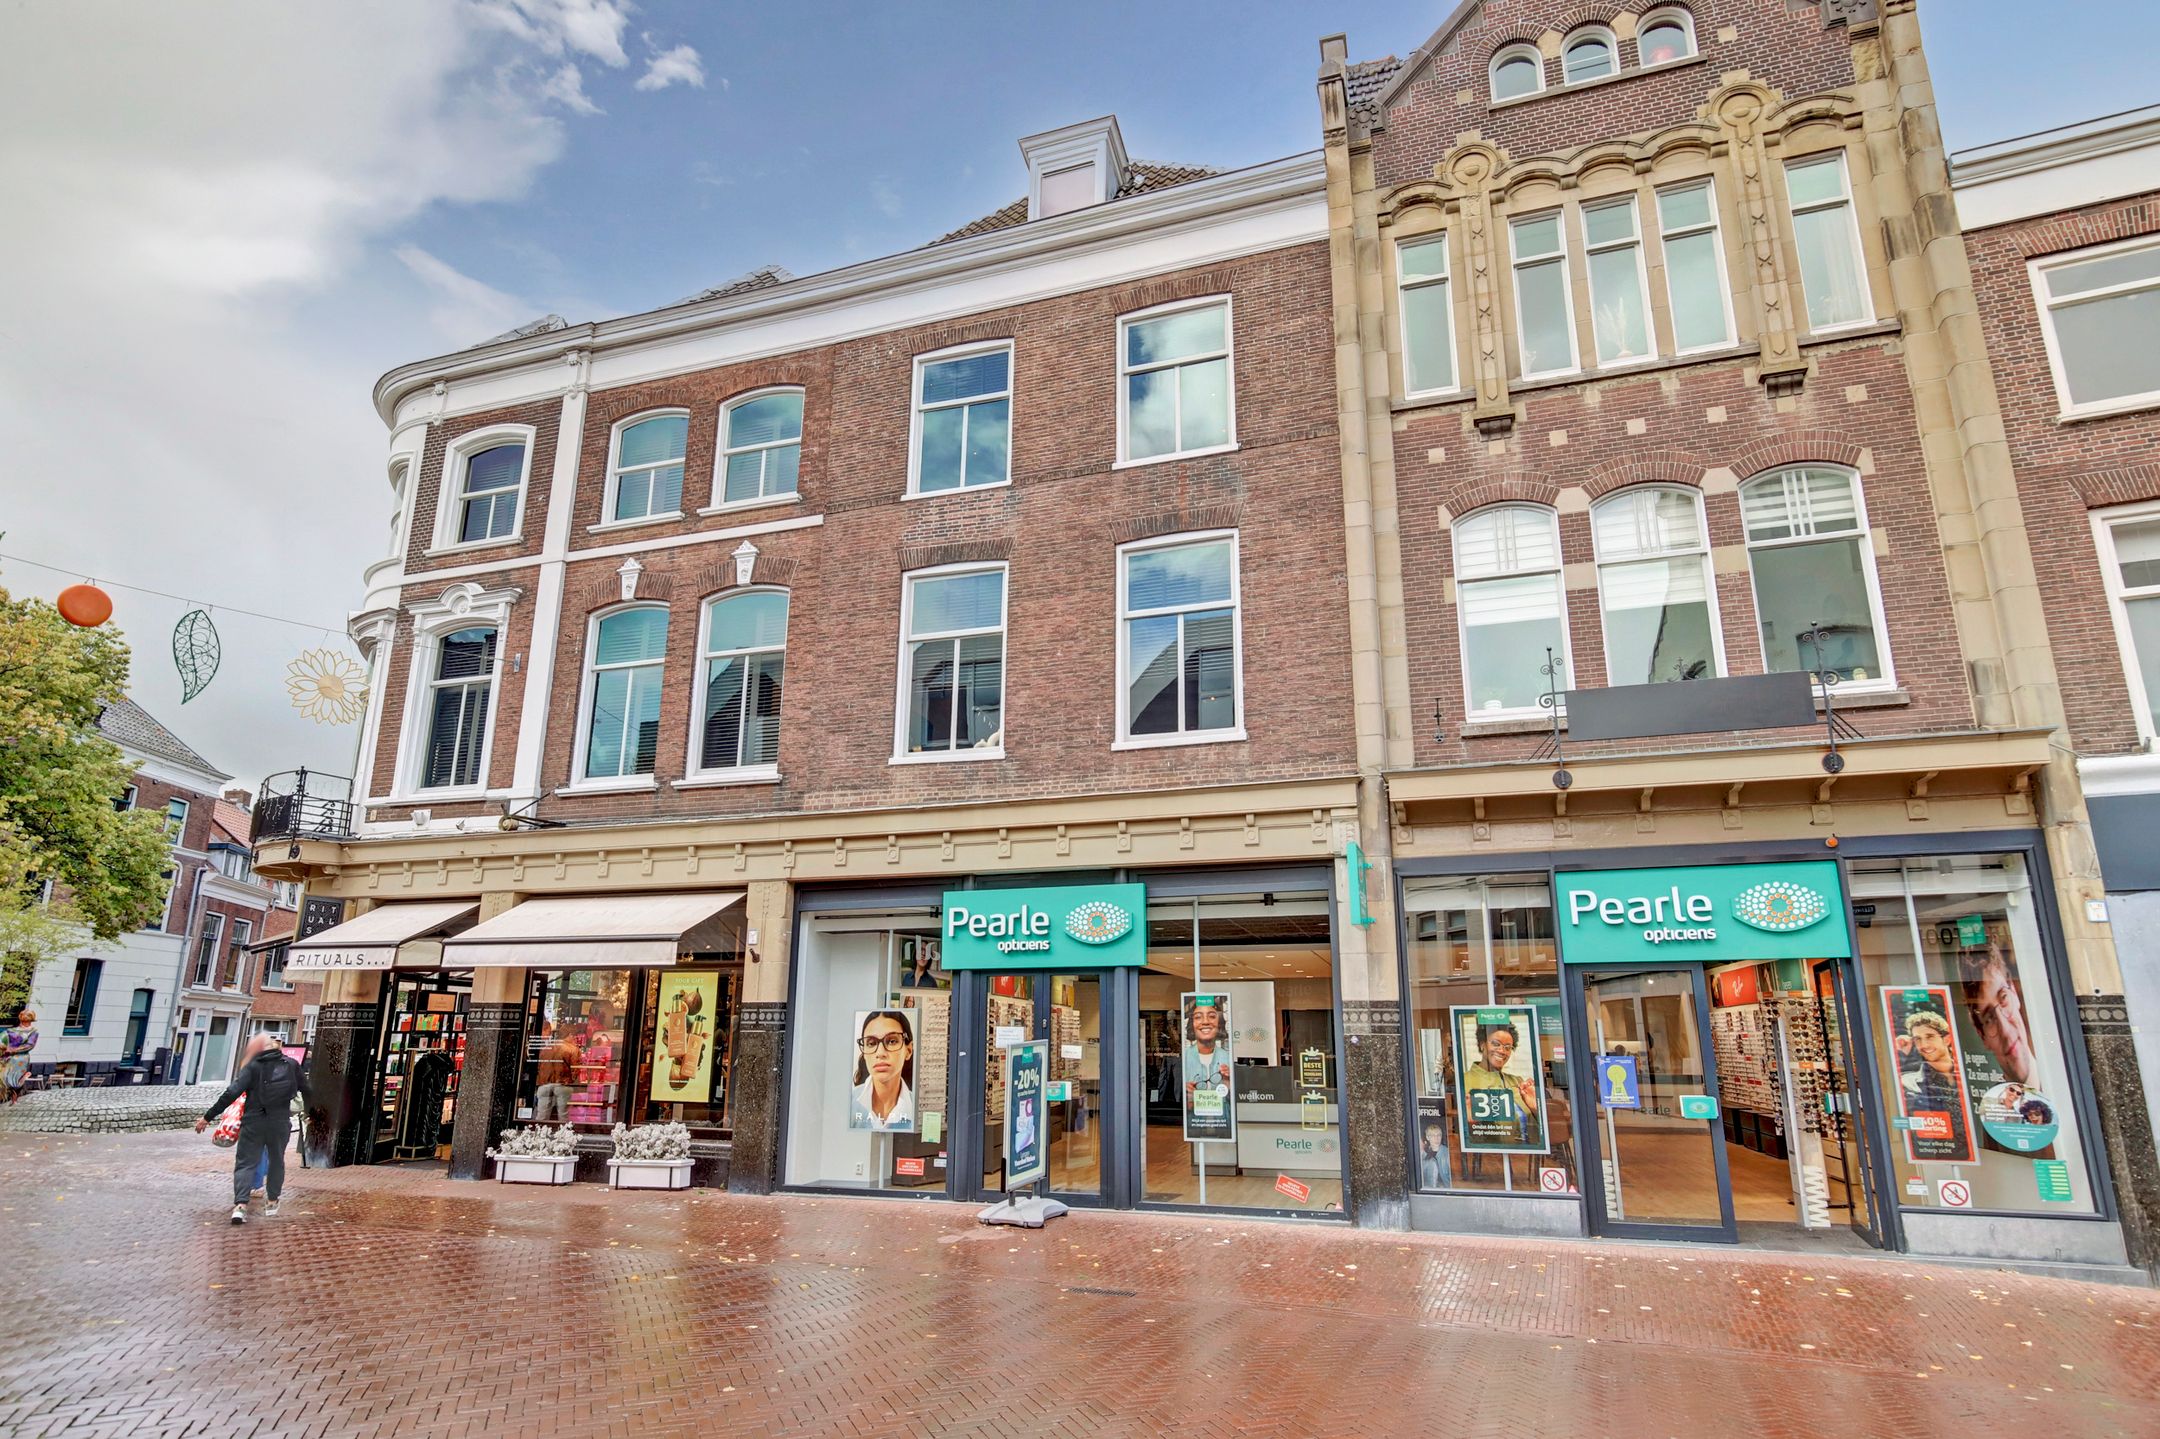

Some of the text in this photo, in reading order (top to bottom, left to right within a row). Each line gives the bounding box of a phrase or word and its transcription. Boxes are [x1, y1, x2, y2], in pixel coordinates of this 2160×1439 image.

[1568, 886, 1713, 925] Pearle
[948, 904, 1050, 937] Pearle
[1643, 927, 1717, 944] opticiens
[997, 939, 1050, 953] opticiens
[296, 953, 385, 966] RITUALS...
[1014, 1067, 1040, 1090] -20%
[1238, 1093, 1275, 1101] welkom
[1474, 1093, 1490, 1118] 3
[1490, 1094, 1501, 1117] voor
[1500, 1093, 1511, 1118] 1
[1276, 1138, 1312, 1149] Pearle
